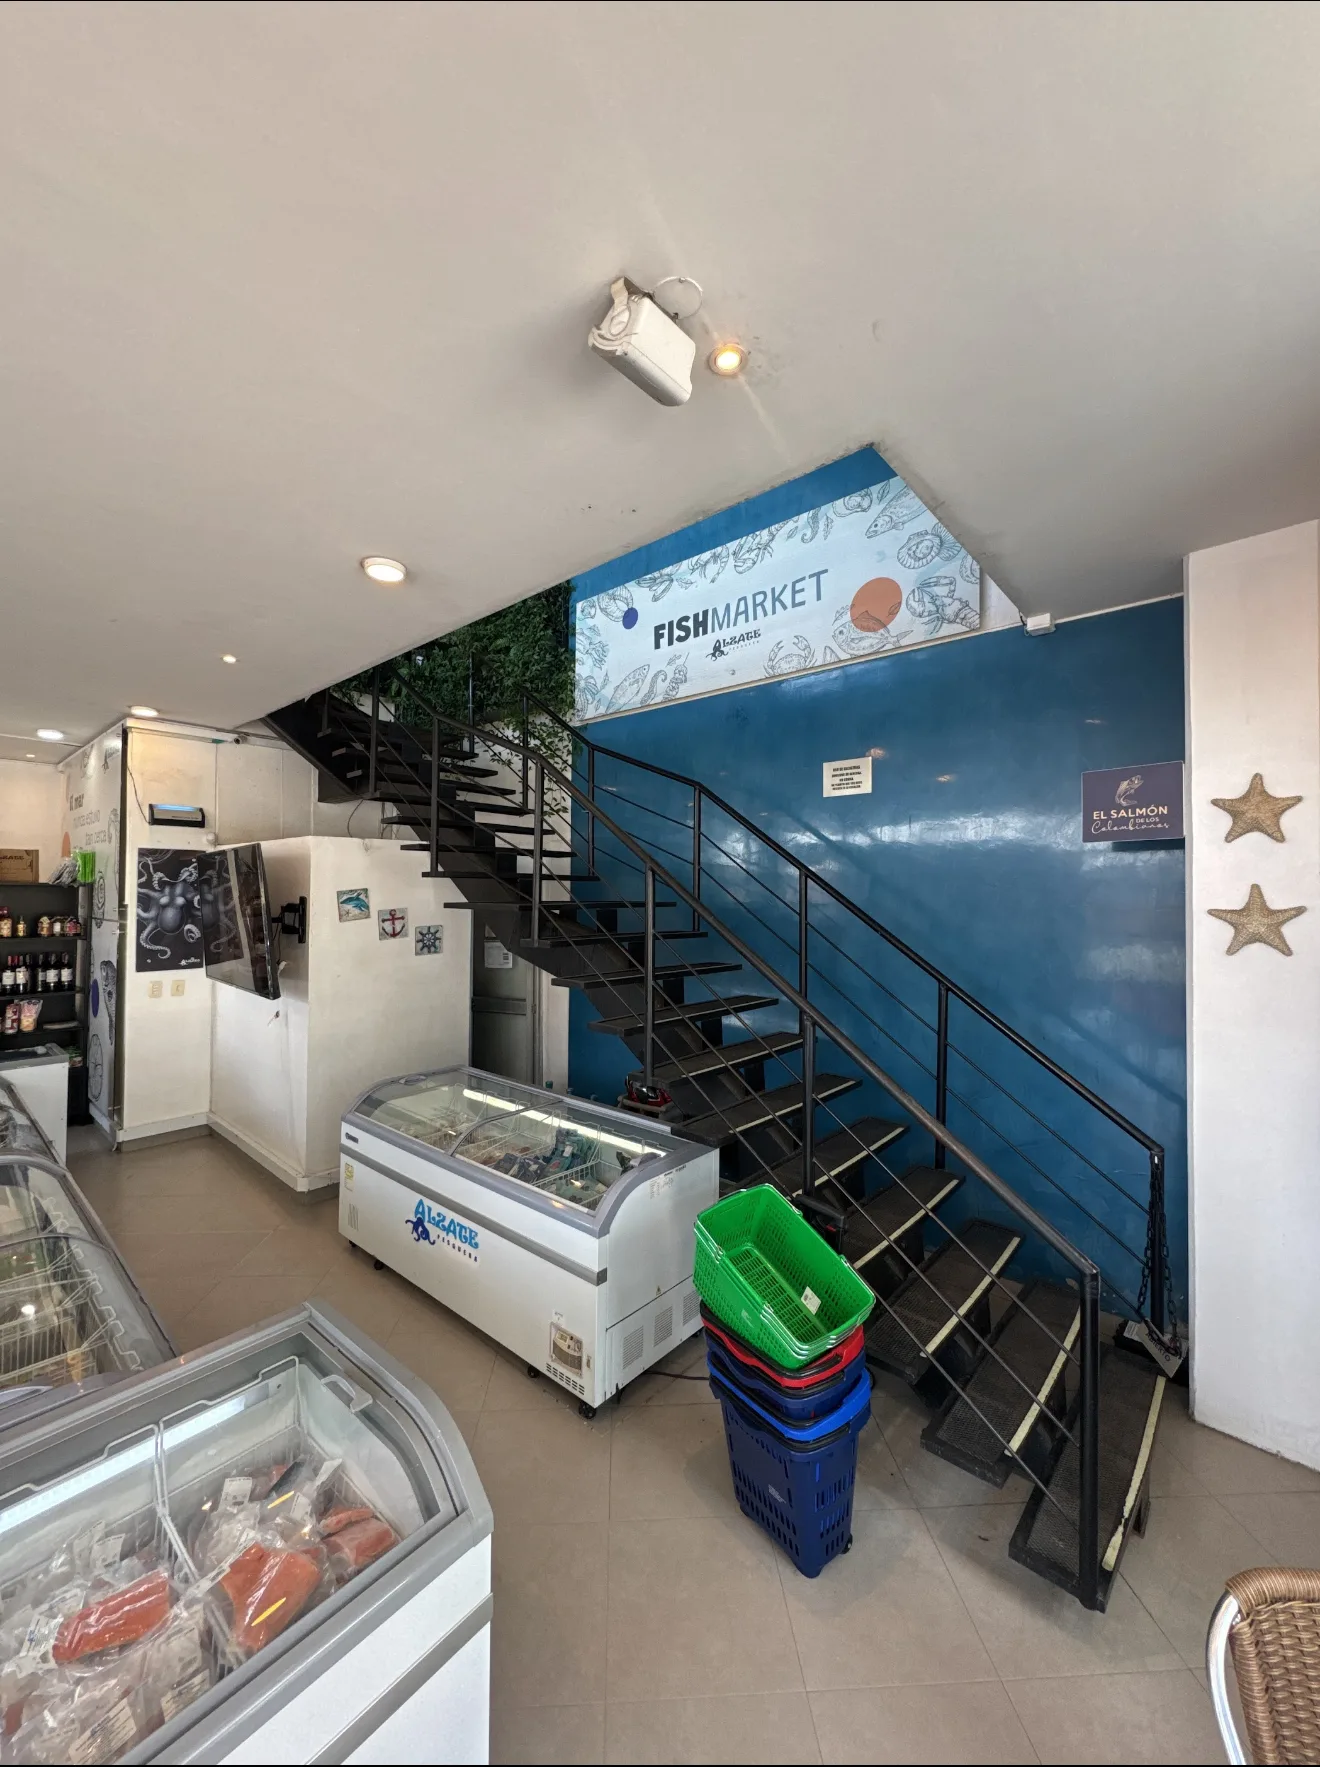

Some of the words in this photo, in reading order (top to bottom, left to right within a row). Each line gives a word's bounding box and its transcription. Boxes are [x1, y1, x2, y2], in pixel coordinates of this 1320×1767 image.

[654, 569, 829, 650] FISHMARKET
[1093, 811, 1107, 820] EL
[1111, 804, 1168, 819] SALMÓN
